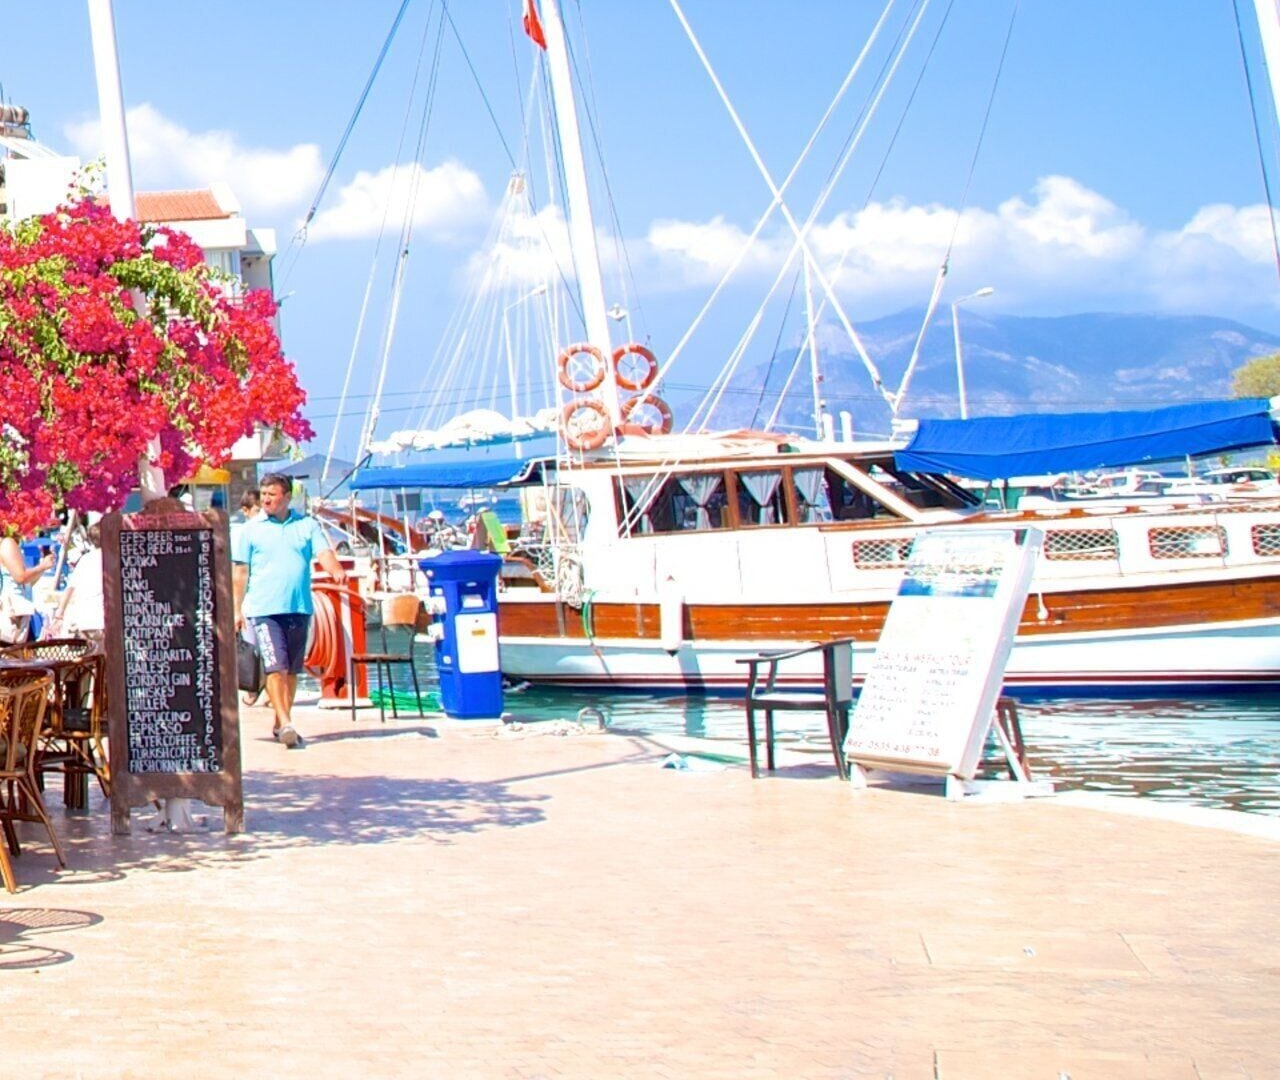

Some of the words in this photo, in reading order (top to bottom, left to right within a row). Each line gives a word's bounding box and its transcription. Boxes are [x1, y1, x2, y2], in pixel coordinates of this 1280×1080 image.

[121, 532, 146, 544] EFES
[148, 532, 173, 542] BEER
[121, 544, 145, 556] EFES
[148, 542, 173, 554] BEER
[122, 555, 158, 567] VODKA
[199, 554, 209, 566] 15
[122, 567, 142, 579] GIN
[199, 567, 210, 579] 15
[124, 579, 149, 591] RAKI
[124, 591, 155, 603] WINE
[124, 602, 171, 615] MARTINI
[196, 626, 213, 638] 25
[125, 639, 170, 651] MOJITO
[126, 649, 193, 662] MARGUARITA
[197, 649, 213, 661] 25
[196, 661, 214, 673] 25
[126, 674, 170, 687] GORDON
[171, 673, 191, 686] GIN
[197, 673, 213, 685] 25
[127, 686, 175, 699] WHISKEY
[196, 684, 214, 696] 25
[128, 698, 170, 711] MILLER
[200, 697, 213, 709] 12
[128, 711, 191, 723] CAPPUCCINO
[204, 710, 213, 720] 8
[130, 722, 183, 736] ESPRESSO
[206, 721, 214, 734] 6
[130, 735, 162, 748] FILTER
[163, 733, 198, 747] COFFEE
[205, 734, 213, 746] 6
[131, 748, 169, 760] TURKISH
[170, 746, 202, 759] COFFEE
[208, 746, 217, 758] 5
